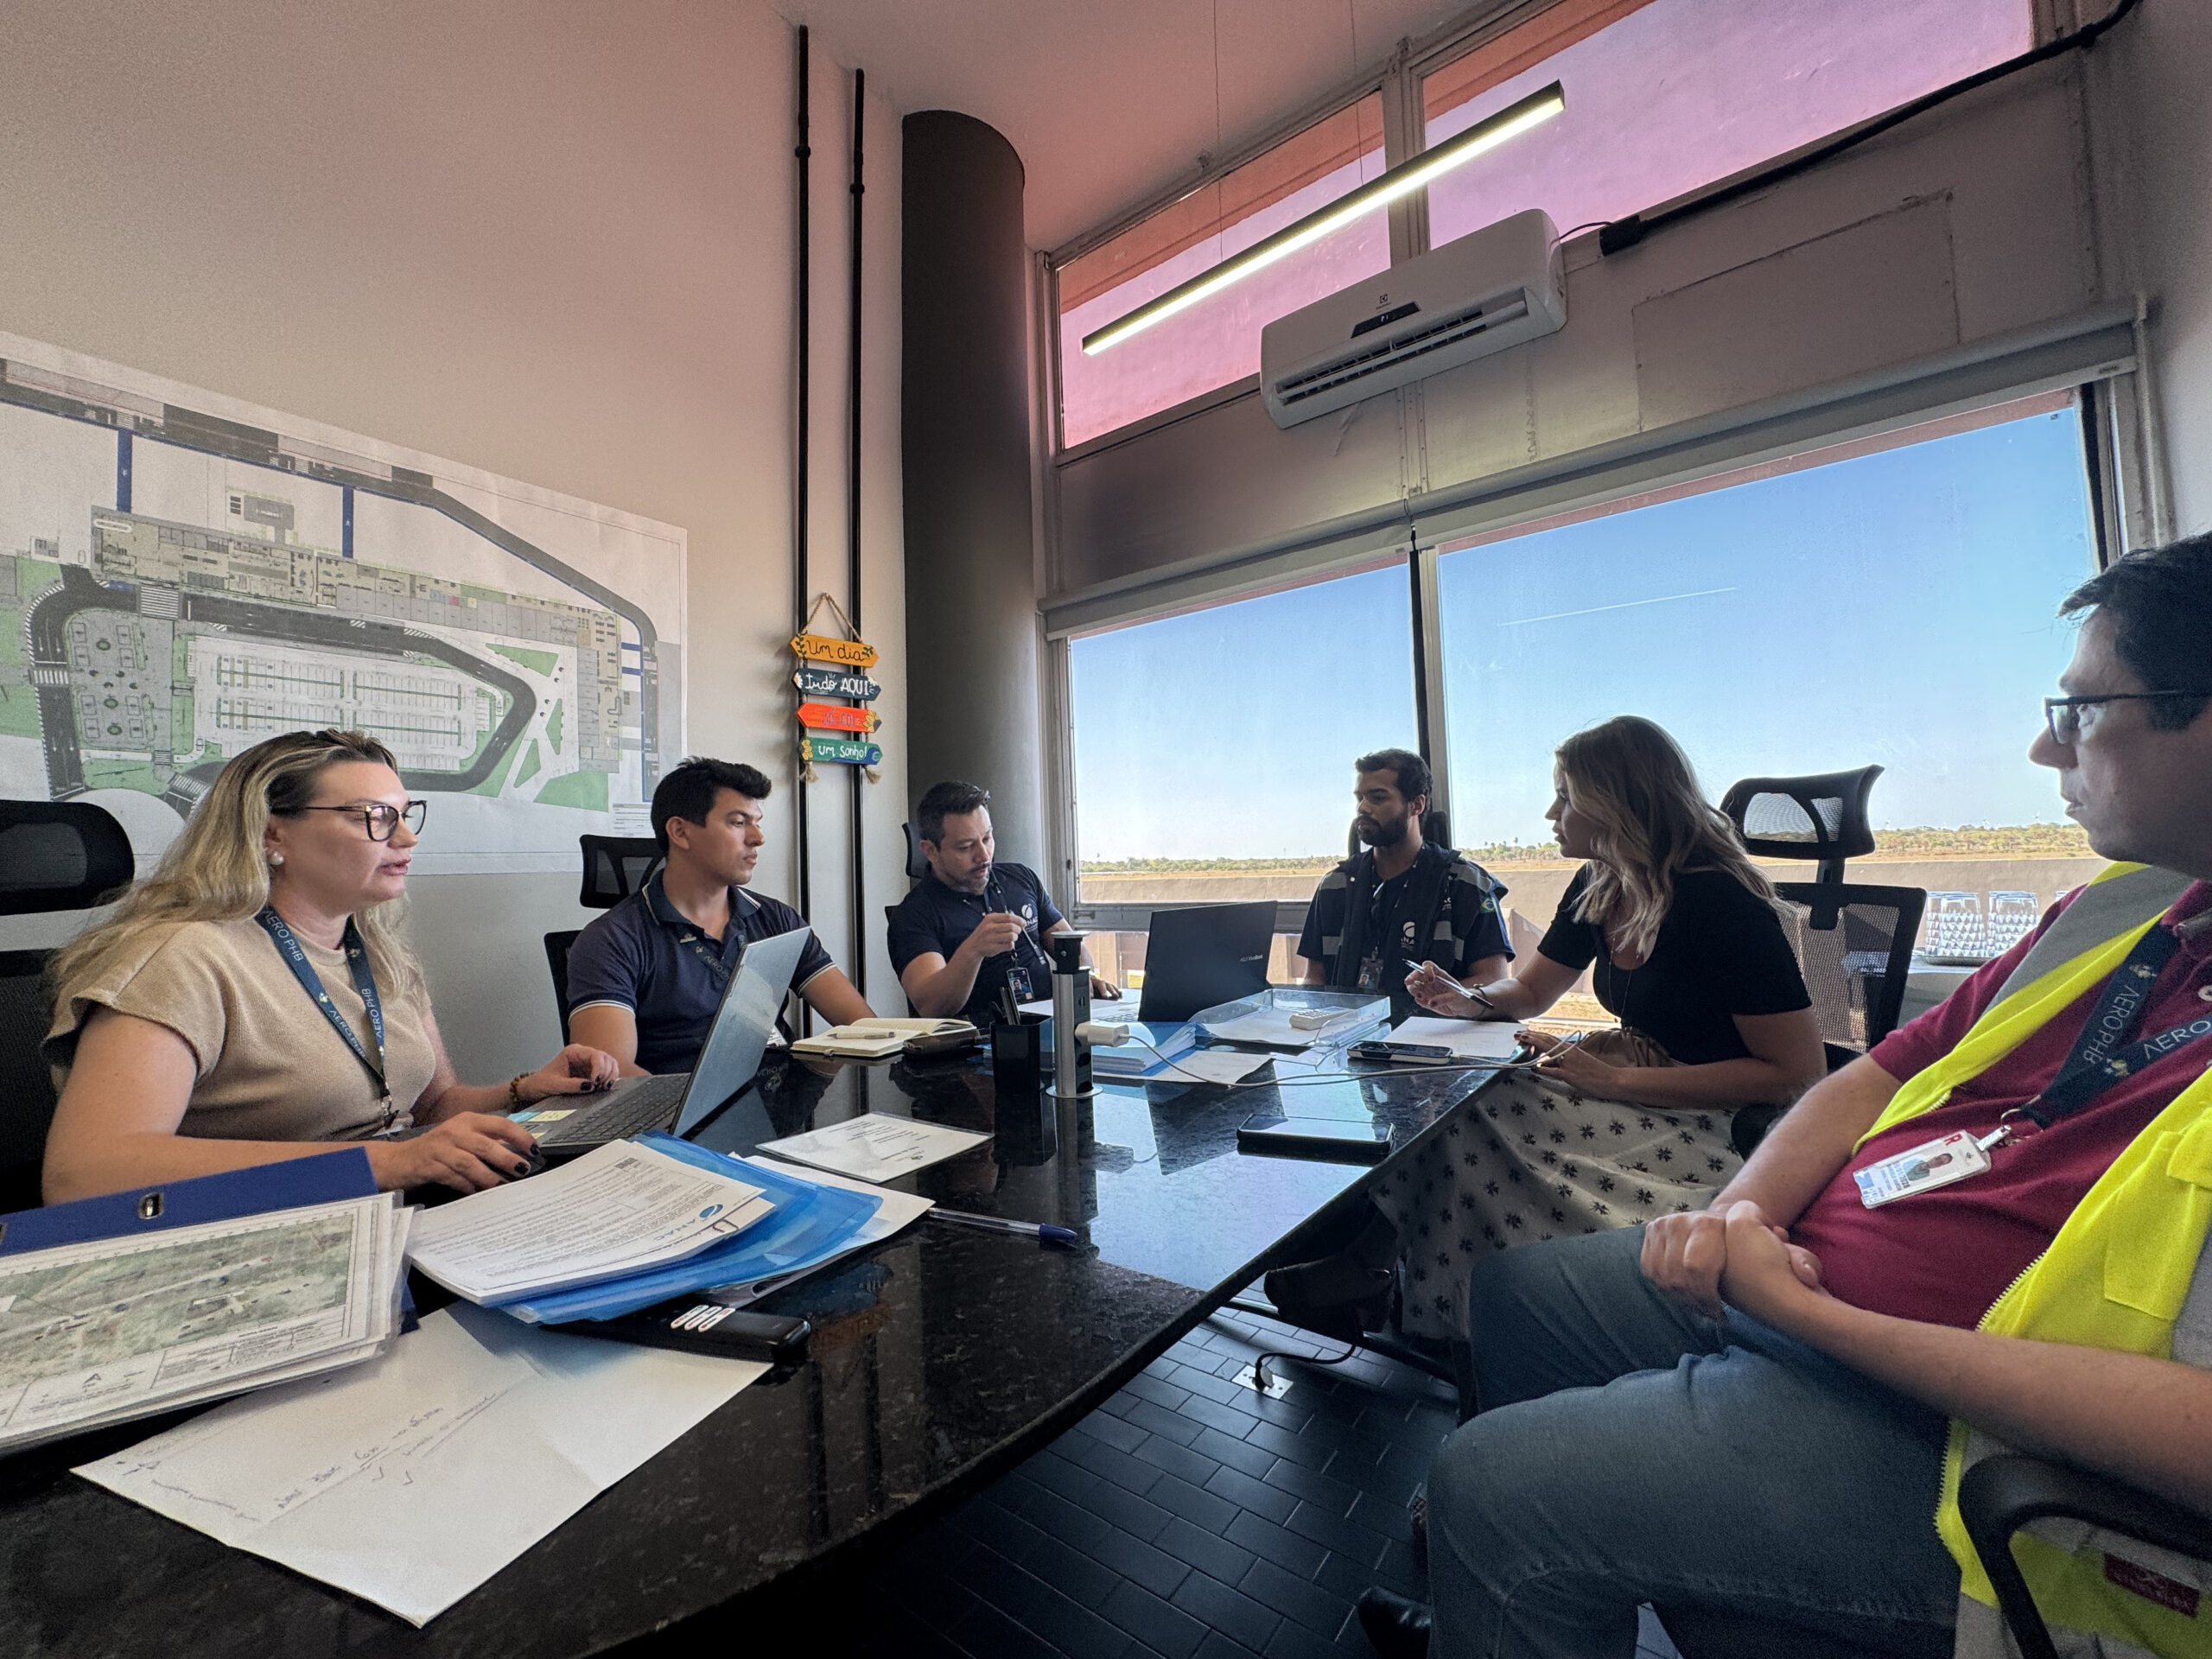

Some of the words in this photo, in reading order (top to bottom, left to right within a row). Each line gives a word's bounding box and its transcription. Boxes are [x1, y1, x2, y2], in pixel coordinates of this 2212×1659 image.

[806, 639, 834, 658] Um
[837, 644, 864, 662] dia
[840, 677, 869, 696] AQUI
[263, 911, 289, 938] AERO
[284, 938, 303, 961] PHB
[361, 988, 376, 1007] PHB
[2102, 984, 2140, 1030] AERO
[370, 1008, 383, 1039] AERO
[2143, 1020, 2212, 1060] AERO
[2082, 1029, 2114, 1065] PHB
